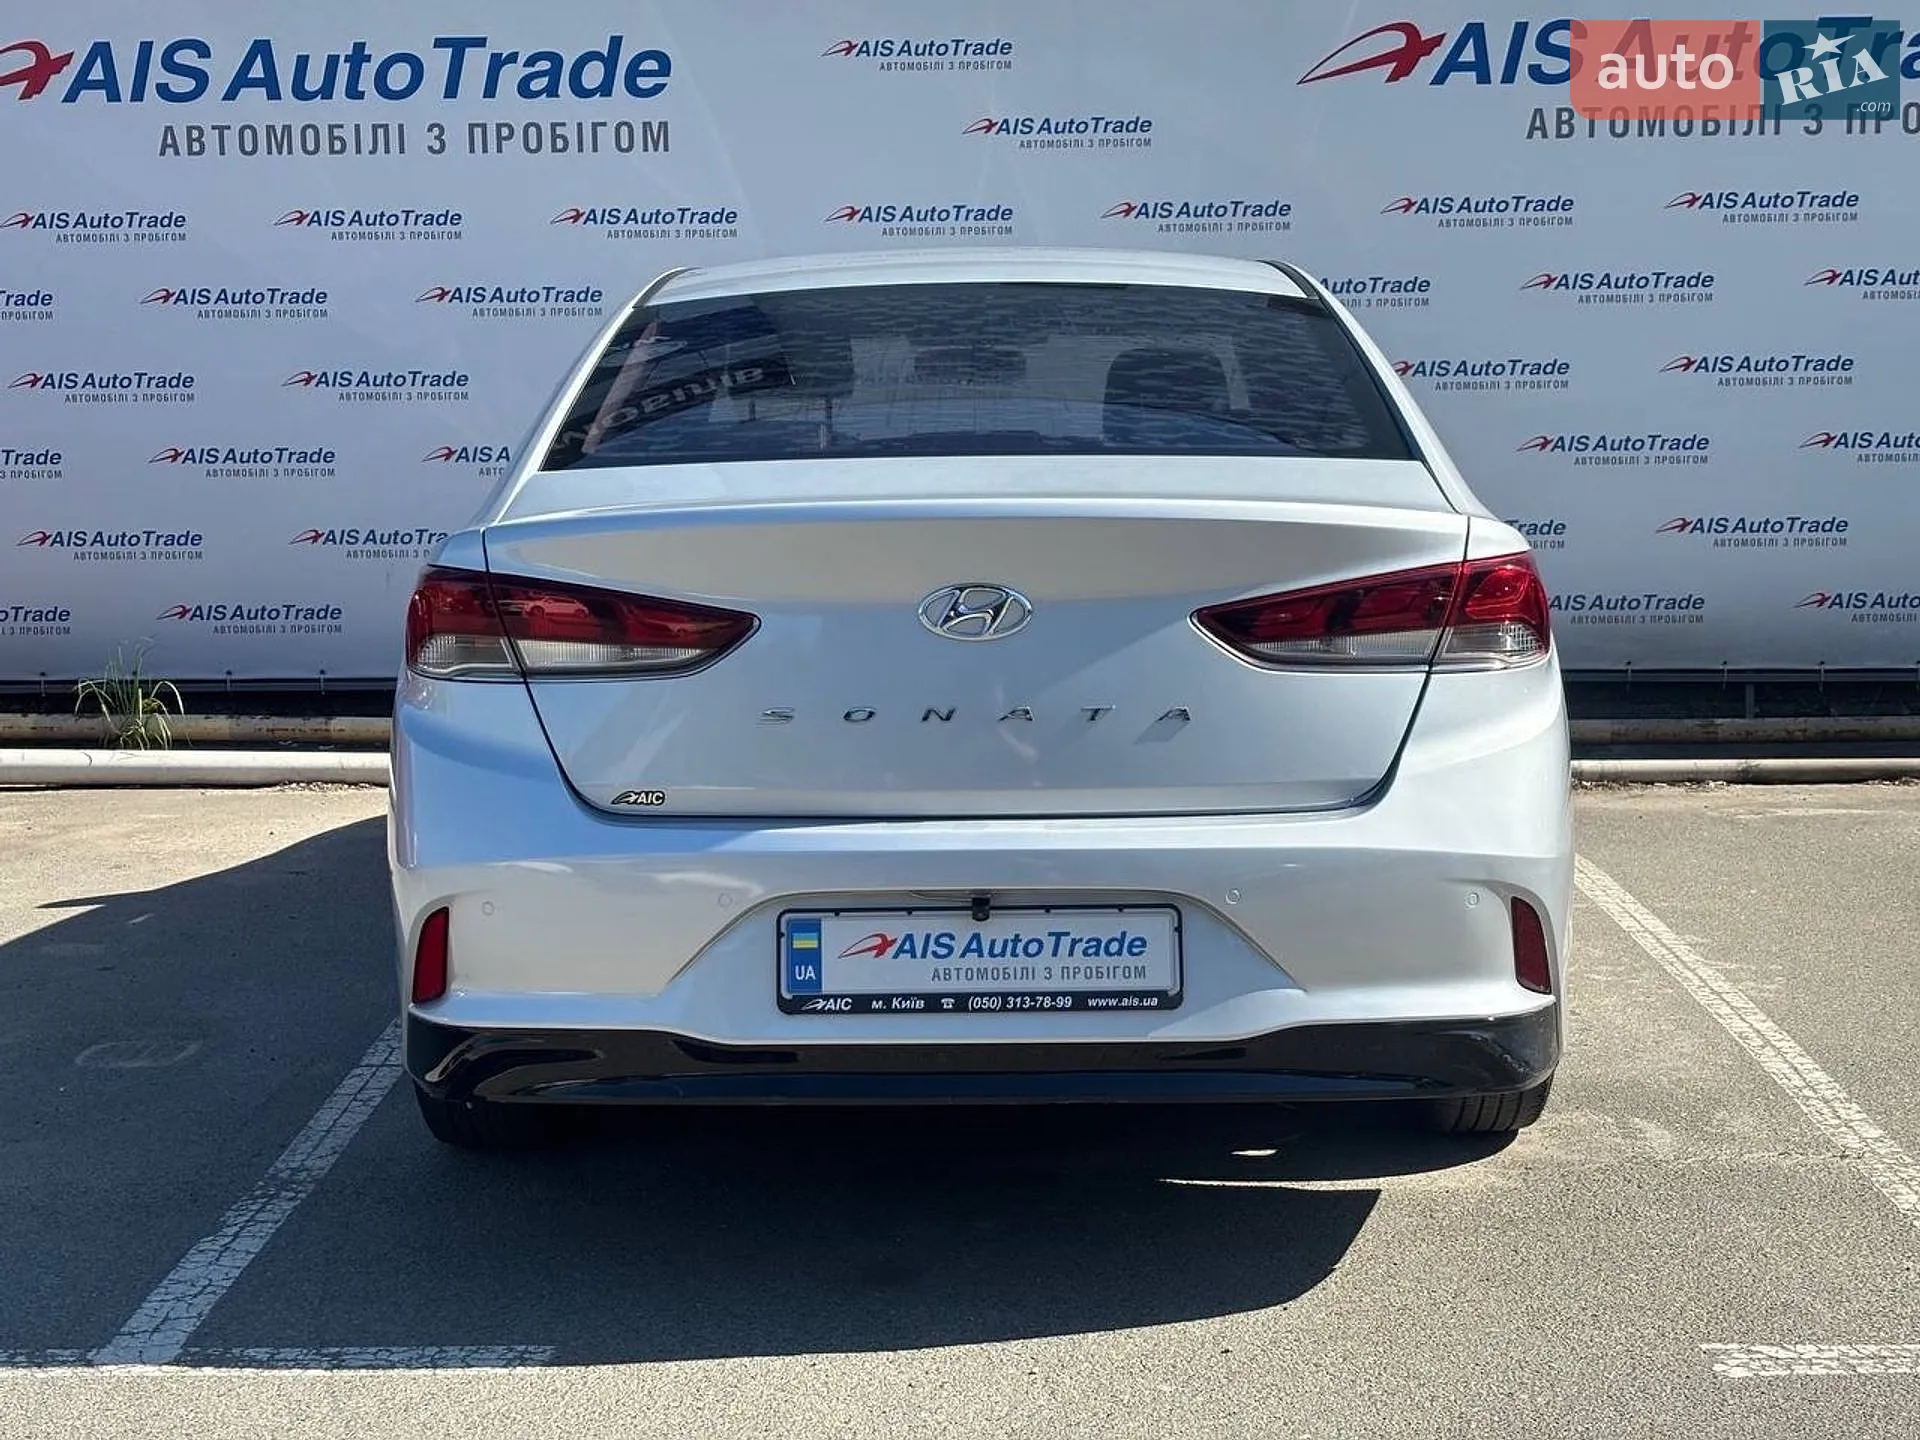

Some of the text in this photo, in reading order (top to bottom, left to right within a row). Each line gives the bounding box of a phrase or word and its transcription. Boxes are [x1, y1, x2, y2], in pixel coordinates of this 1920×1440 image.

[854, 39, 1012, 57] AIS AutoTrade
[1429, 18, 1586, 86] AIS
[62, 35, 672, 103] AIS AutoTrade
[995, 117, 1152, 135] AIS AutoTrade
[158, 123, 405, 157] АВТОМОБІЛІ
[467, 120, 671, 154] ПРОБІГОМ
[1414, 196, 1574, 214] AIS AutoTrade
[1698, 191, 1859, 209] AIS AutoTrade
[306, 210, 462, 226] AIS AutoTrade
[581, 208, 737, 224] AIS AutoTrade
[858, 205, 1013, 222] AIS AutoTrade
[1133, 201, 1291, 219] AIS AutoTrade
[31, 212, 185, 229] AIS AutoTrade
[1552, 272, 1714, 290] AIS AutoTrade
[1837, 269, 1878, 286] AIS
[171, 288, 327, 305] AIS AutoTrade
[447, 287, 602, 303] AIS AutoTrade
[1411, 360, 1569, 377] AIS AutoTrade
[1693, 356, 1853, 373] AIS AutoTrade
[40, 373, 194, 389] AIS AutoTrade
[314, 371, 468, 387] AIS AutoTrade
[1550, 435, 1709, 452] AIS AutoTrade
[1832, 432, 1873, 448] AIS
[181, 448, 335, 464] AIS AutoTrade
[454, 447, 493, 463] AIS
[1689, 517, 1848, 533] AIS AutoTrade
[49, 531, 202, 547] AIS AutoTrade
[321, 529, 359, 545] AIS
[1548, 595, 1704, 611] AIS AutoTrade
[1828, 593, 1868, 609] AIS
[189, 605, 342, 620] AIS AutoTrade
[759, 706, 1191, 724] SONATA
[892, 931, 1148, 960] AIS AutoTrade
[795, 965, 816, 980] UA
[931, 966, 1035, 982] АВТОМОБІЛІ
[1061, 964, 1147, 980] ПРОБІГОМ
[892, 997, 925, 1010] Київ
[968, 996, 1003, 1010] (050)
[1006, 996, 1072, 1009] 313-78-99
[1087, 997, 1158, 1008] www.ais.ua
